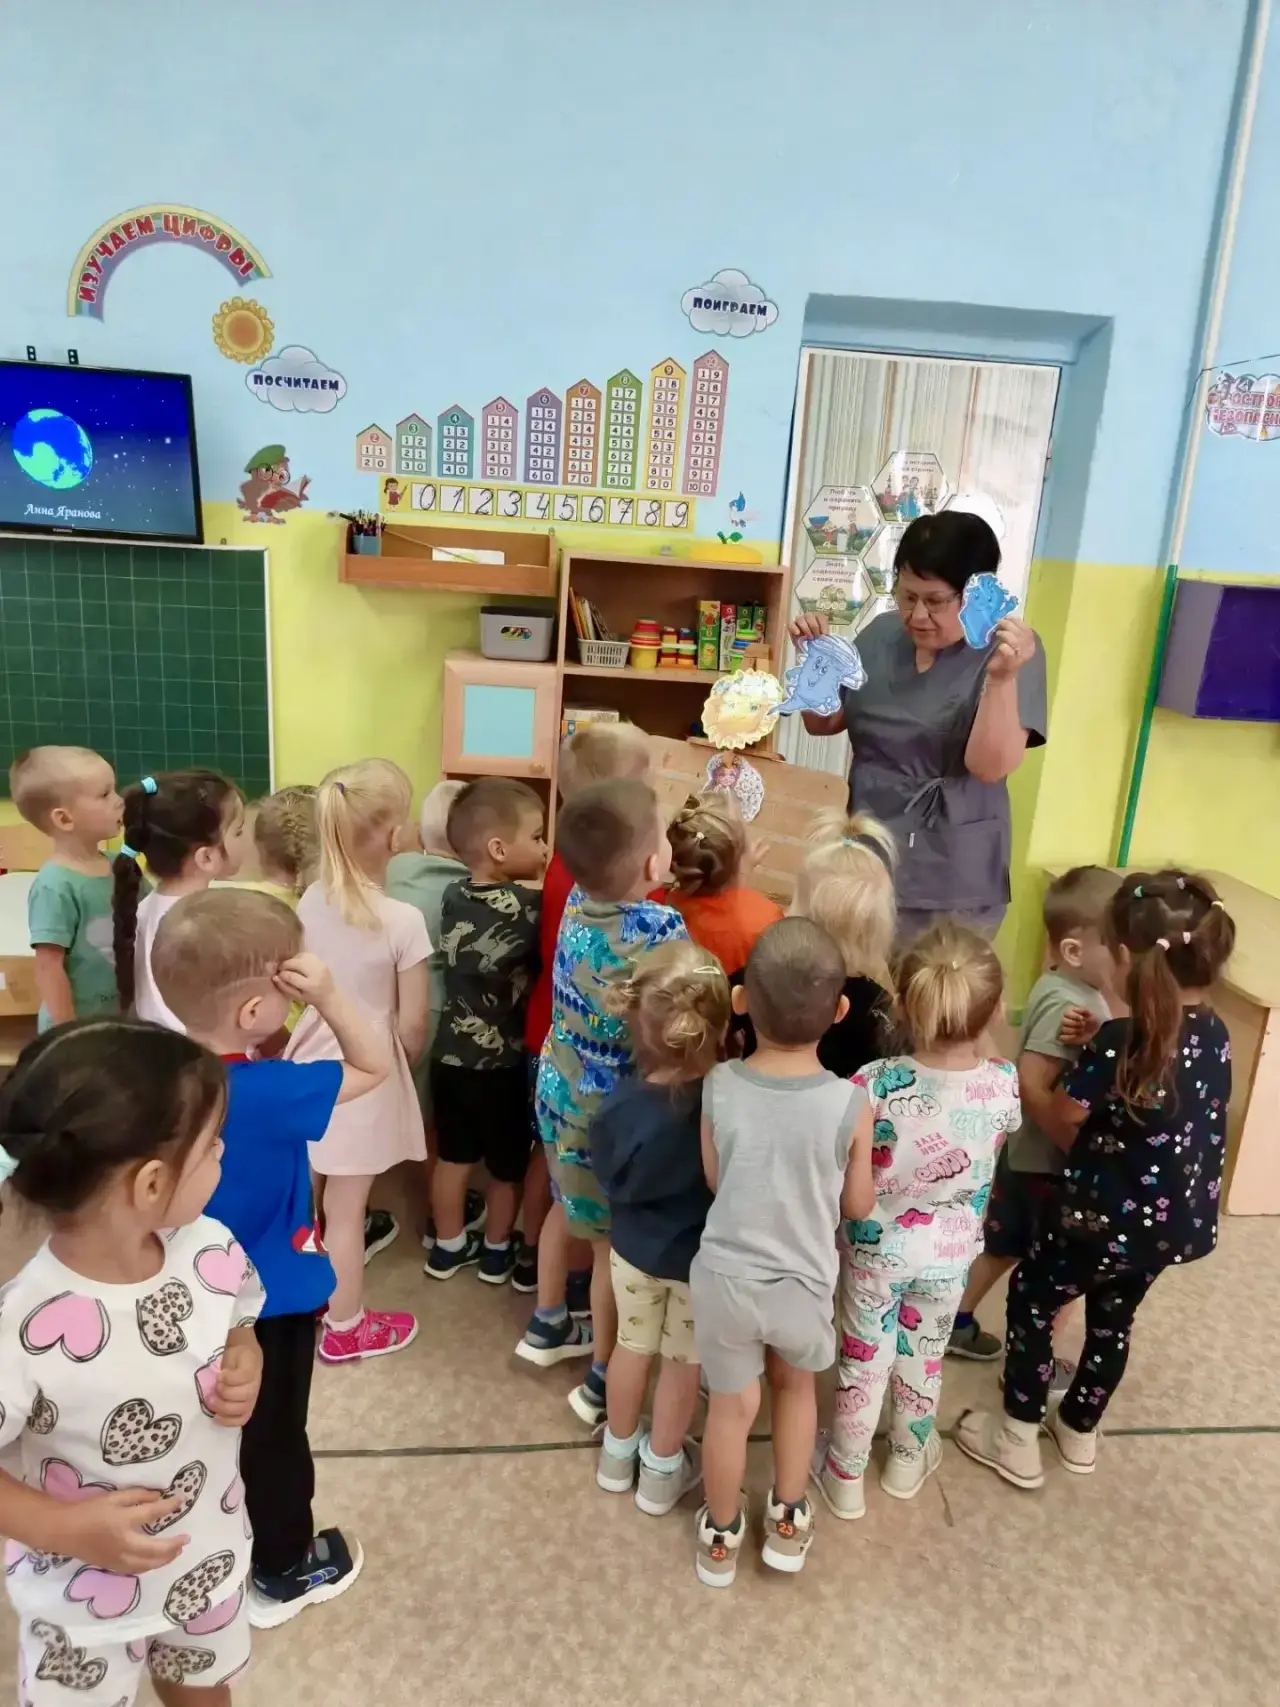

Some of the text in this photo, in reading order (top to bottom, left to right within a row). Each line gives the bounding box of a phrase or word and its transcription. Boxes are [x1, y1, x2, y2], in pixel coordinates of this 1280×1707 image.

[78, 213, 256, 303] ИЗУЧАЕМ ЦИФРЫ
[693, 297, 768, 316] ПОИГРАЕМ
[253, 374, 339, 391] ПОСЧИТАЕМ
[671, 380, 677, 388] 8
[712, 384, 718, 392] 8
[614, 389, 634, 397] 1 7
[656, 392, 663, 400] 2
[698, 395, 718, 405] 3 7
[614, 401, 620, 409] 2
[656, 404, 675, 414] 3 6
[547, 410, 554, 418] 5
[573, 412, 580, 420] 2
[710, 410, 716, 418] 6
[490, 417, 496, 425] 1
[626, 415, 632, 423] 5
[668, 418, 674, 426] 5
[534, 421, 540, 429] 2
[573, 424, 579, 432] 3
[696, 420, 715, 430] 5 5
[446, 427, 466, 436] 1 3
[490, 429, 509, 439] 2 3
[654, 430, 660, 438] 5
[404, 436, 424, 446] 1 2
[446, 440, 466, 449] 2 2
[585, 438, 591, 446] 3
[612, 439, 630, 448] 5 3
[503, 443, 509, 452] 2
[652, 443, 672, 452] 6 3
[418, 450, 423, 459] 1
[546, 448, 552, 456] 2
[571, 449, 590, 459] 5 2
[446, 452, 464, 462] 3 1
[503, 456, 508, 464] 1
[624, 453, 630, 461] 2
[664, 456, 671, 464] 2
[364, 458, 384, 468] 2 0
[404, 462, 410, 470] 3
[532, 459, 551, 468] 5 1
[692, 458, 699, 466] 8
[458, 466, 465, 475] 0
[489, 467, 509, 476] 5 0
[610, 464, 616, 472] 7
[532, 471, 551, 481] 6 0
[664, 469, 669, 477] 1
[582, 476, 590, 484] 0
[622, 478, 629, 486] 0
[662, 480, 670, 488] 0
[702, 484, 710, 492] 0
[420, 484, 689, 527] 0 1 2 3 4 5 6 7 8 9
[24, 504, 101, 520] Анна Яранова
